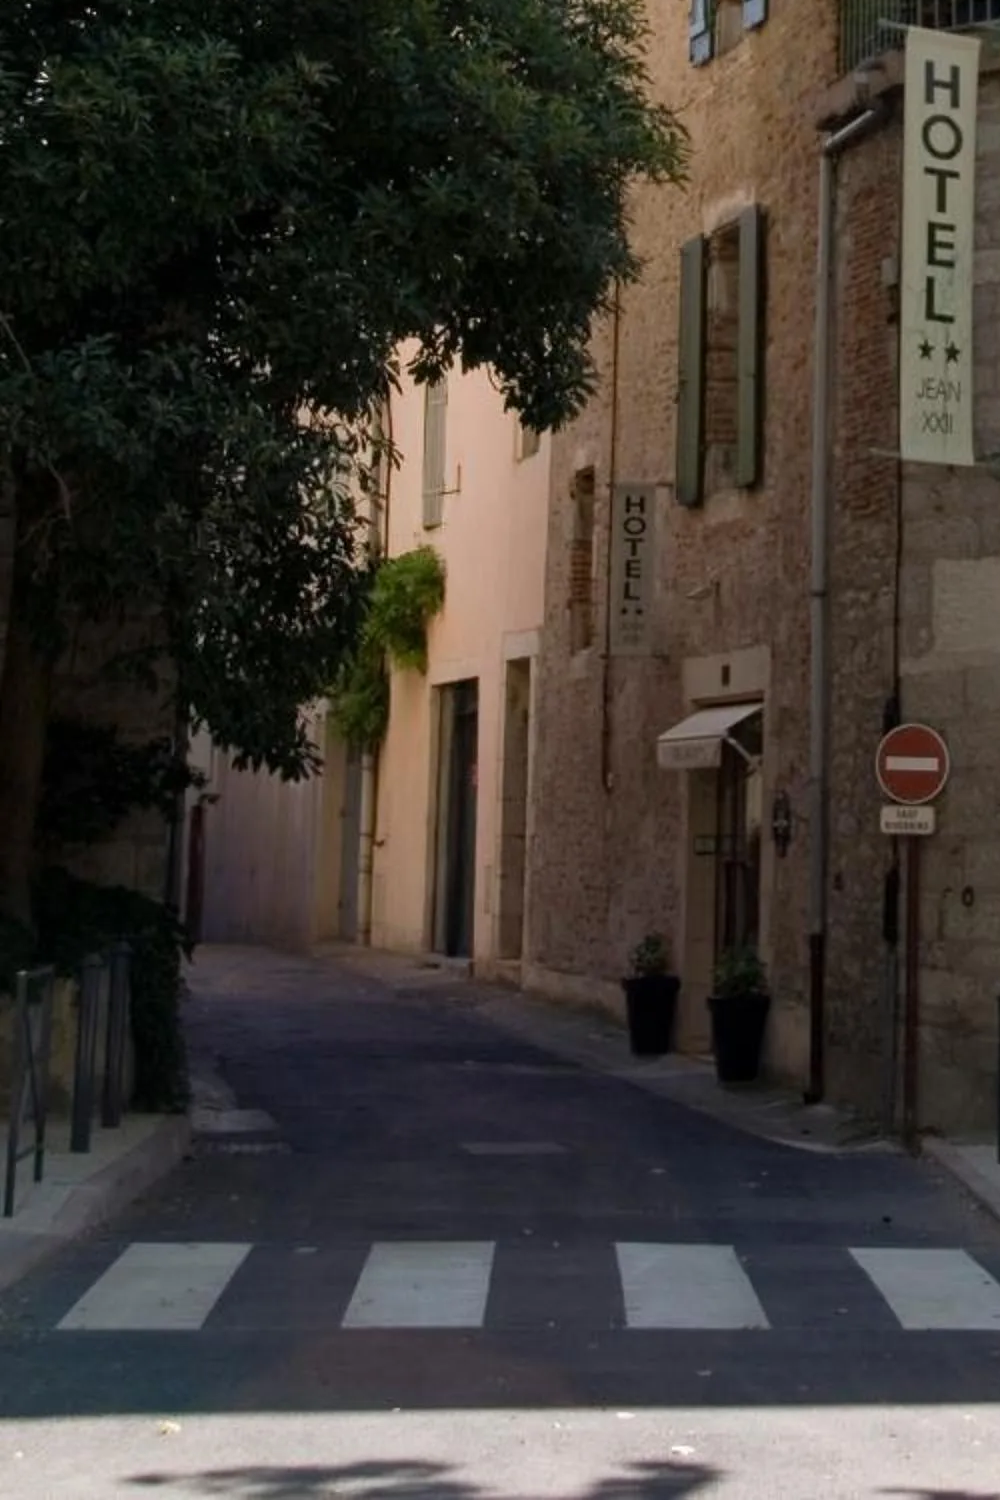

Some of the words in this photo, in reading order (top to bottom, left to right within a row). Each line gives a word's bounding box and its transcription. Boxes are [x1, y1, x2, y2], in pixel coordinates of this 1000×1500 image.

[921, 59, 963, 324] HOTEL
[916, 377, 961, 403] JEAN
[623, 495, 646, 601] HOTEL
